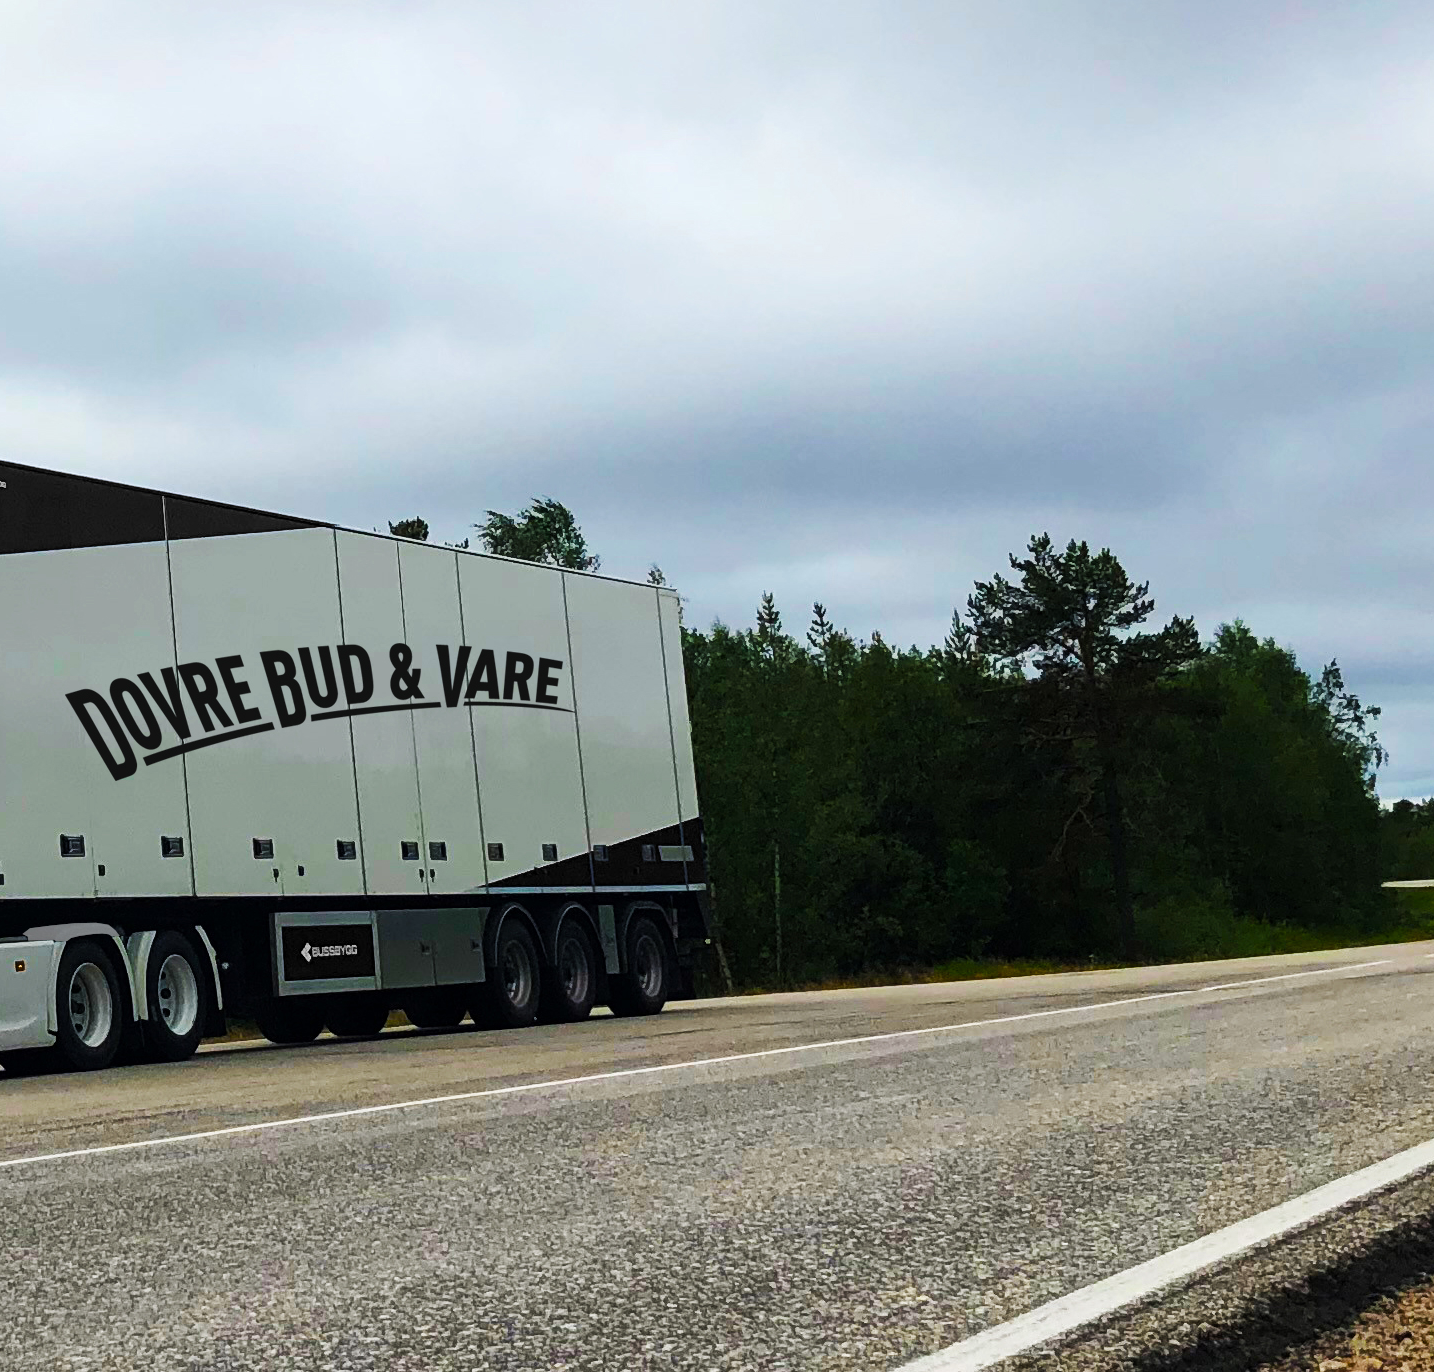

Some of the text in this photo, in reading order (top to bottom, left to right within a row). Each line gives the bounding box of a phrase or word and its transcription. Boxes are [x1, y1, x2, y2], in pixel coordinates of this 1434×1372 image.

[65, 642, 564, 781] DOVRE BUD & VARE
[311, 944, 358, 958] BUSSBYGG
